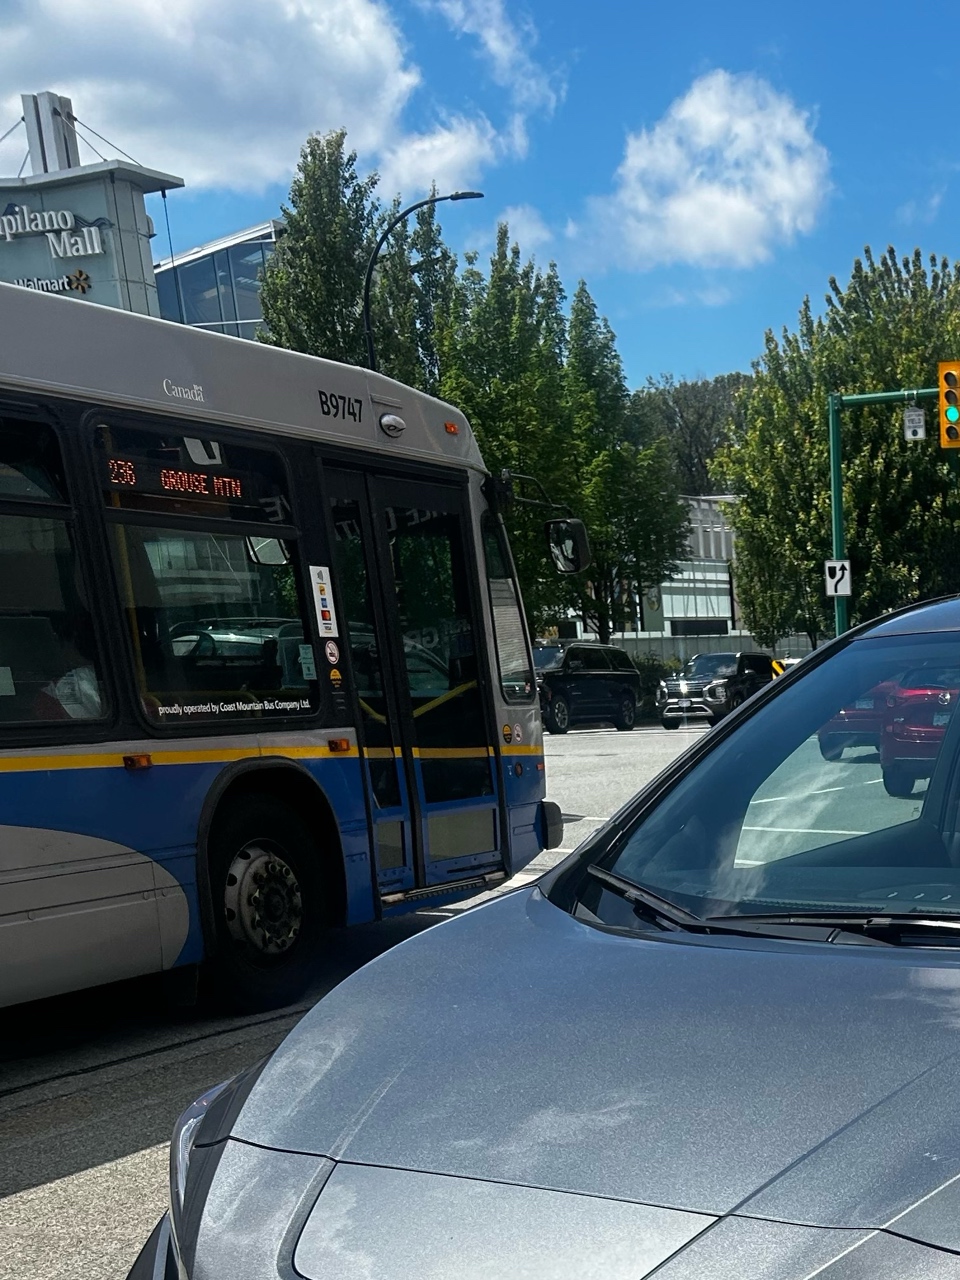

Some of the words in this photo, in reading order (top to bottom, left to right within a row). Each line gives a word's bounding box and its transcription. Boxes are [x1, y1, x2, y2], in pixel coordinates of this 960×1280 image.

[0, 205, 75, 242] pilano
[45, 226, 105, 259] Mall
[163, 378, 205, 402] Canada
[318, 390, 363, 423] B9747
[109, 460, 136, 485] 236
[161, 469, 209, 494] GROUSE
[213, 476, 242, 498] MTN
[158, 703, 183, 716] proudly
[184, 702, 211, 715] operated
[211, 702, 219, 714] by
[219, 702, 236, 712] Coast
[236, 700, 264, 711] Mountain
[264, 700, 275, 710] Bus
[275, 700, 300, 711] Company
[300, 698, 311, 709] Ltd.
